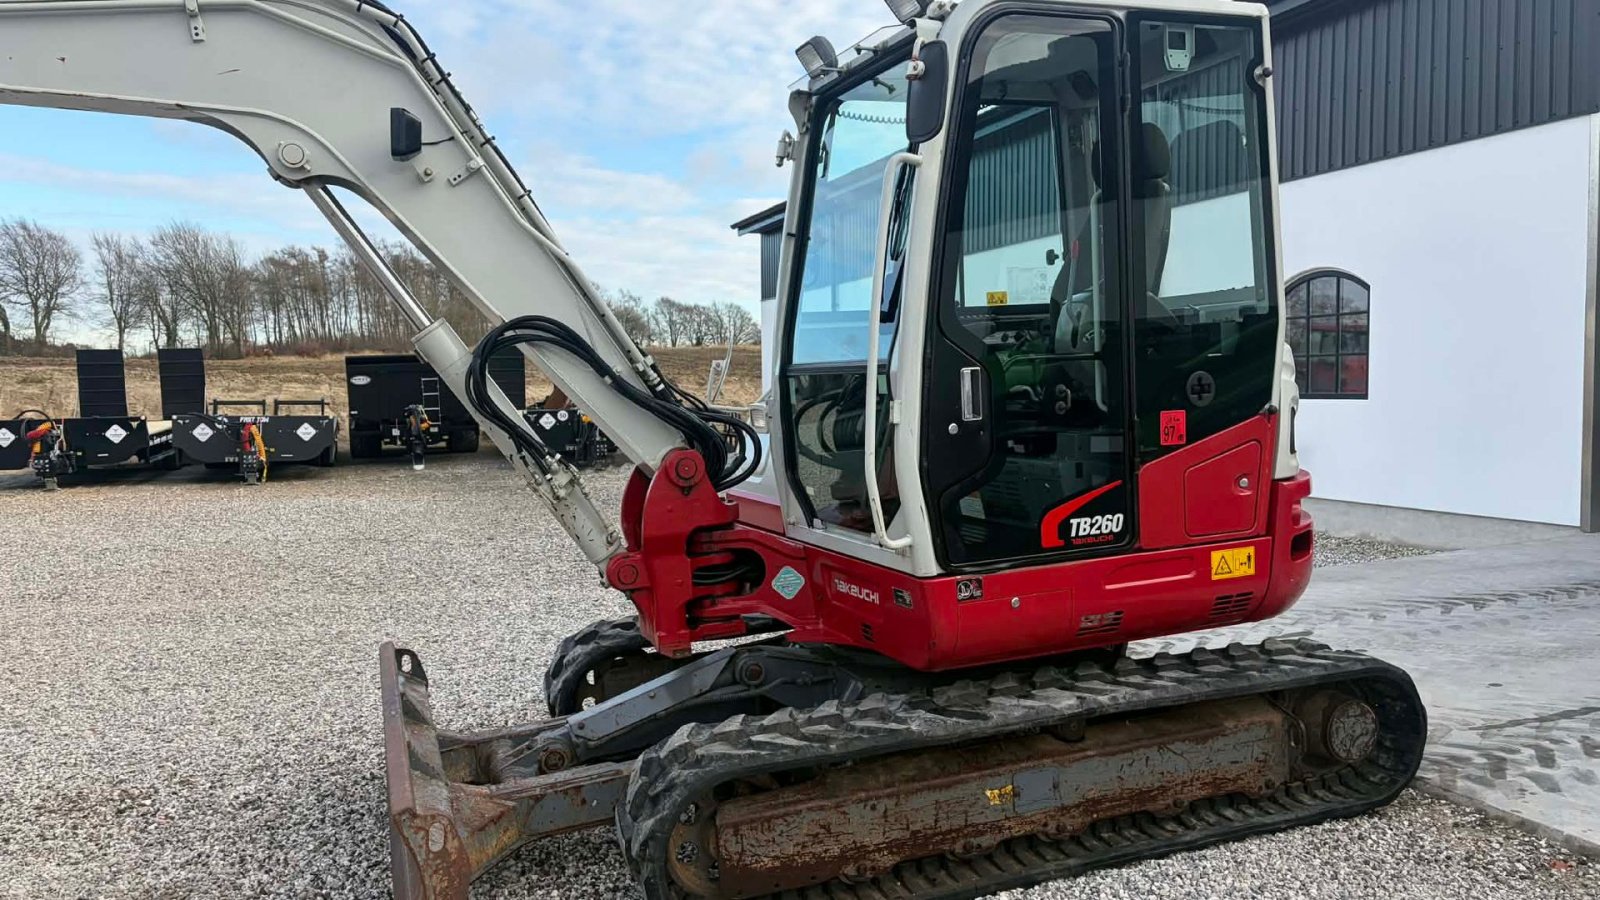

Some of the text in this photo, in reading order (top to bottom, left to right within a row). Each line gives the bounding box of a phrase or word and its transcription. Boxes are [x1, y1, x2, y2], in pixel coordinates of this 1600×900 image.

[1163, 425, 1175, 442] 97
[1069, 513, 1124, 537] TB260
[834, 579, 880, 606] TAKEUCHI
